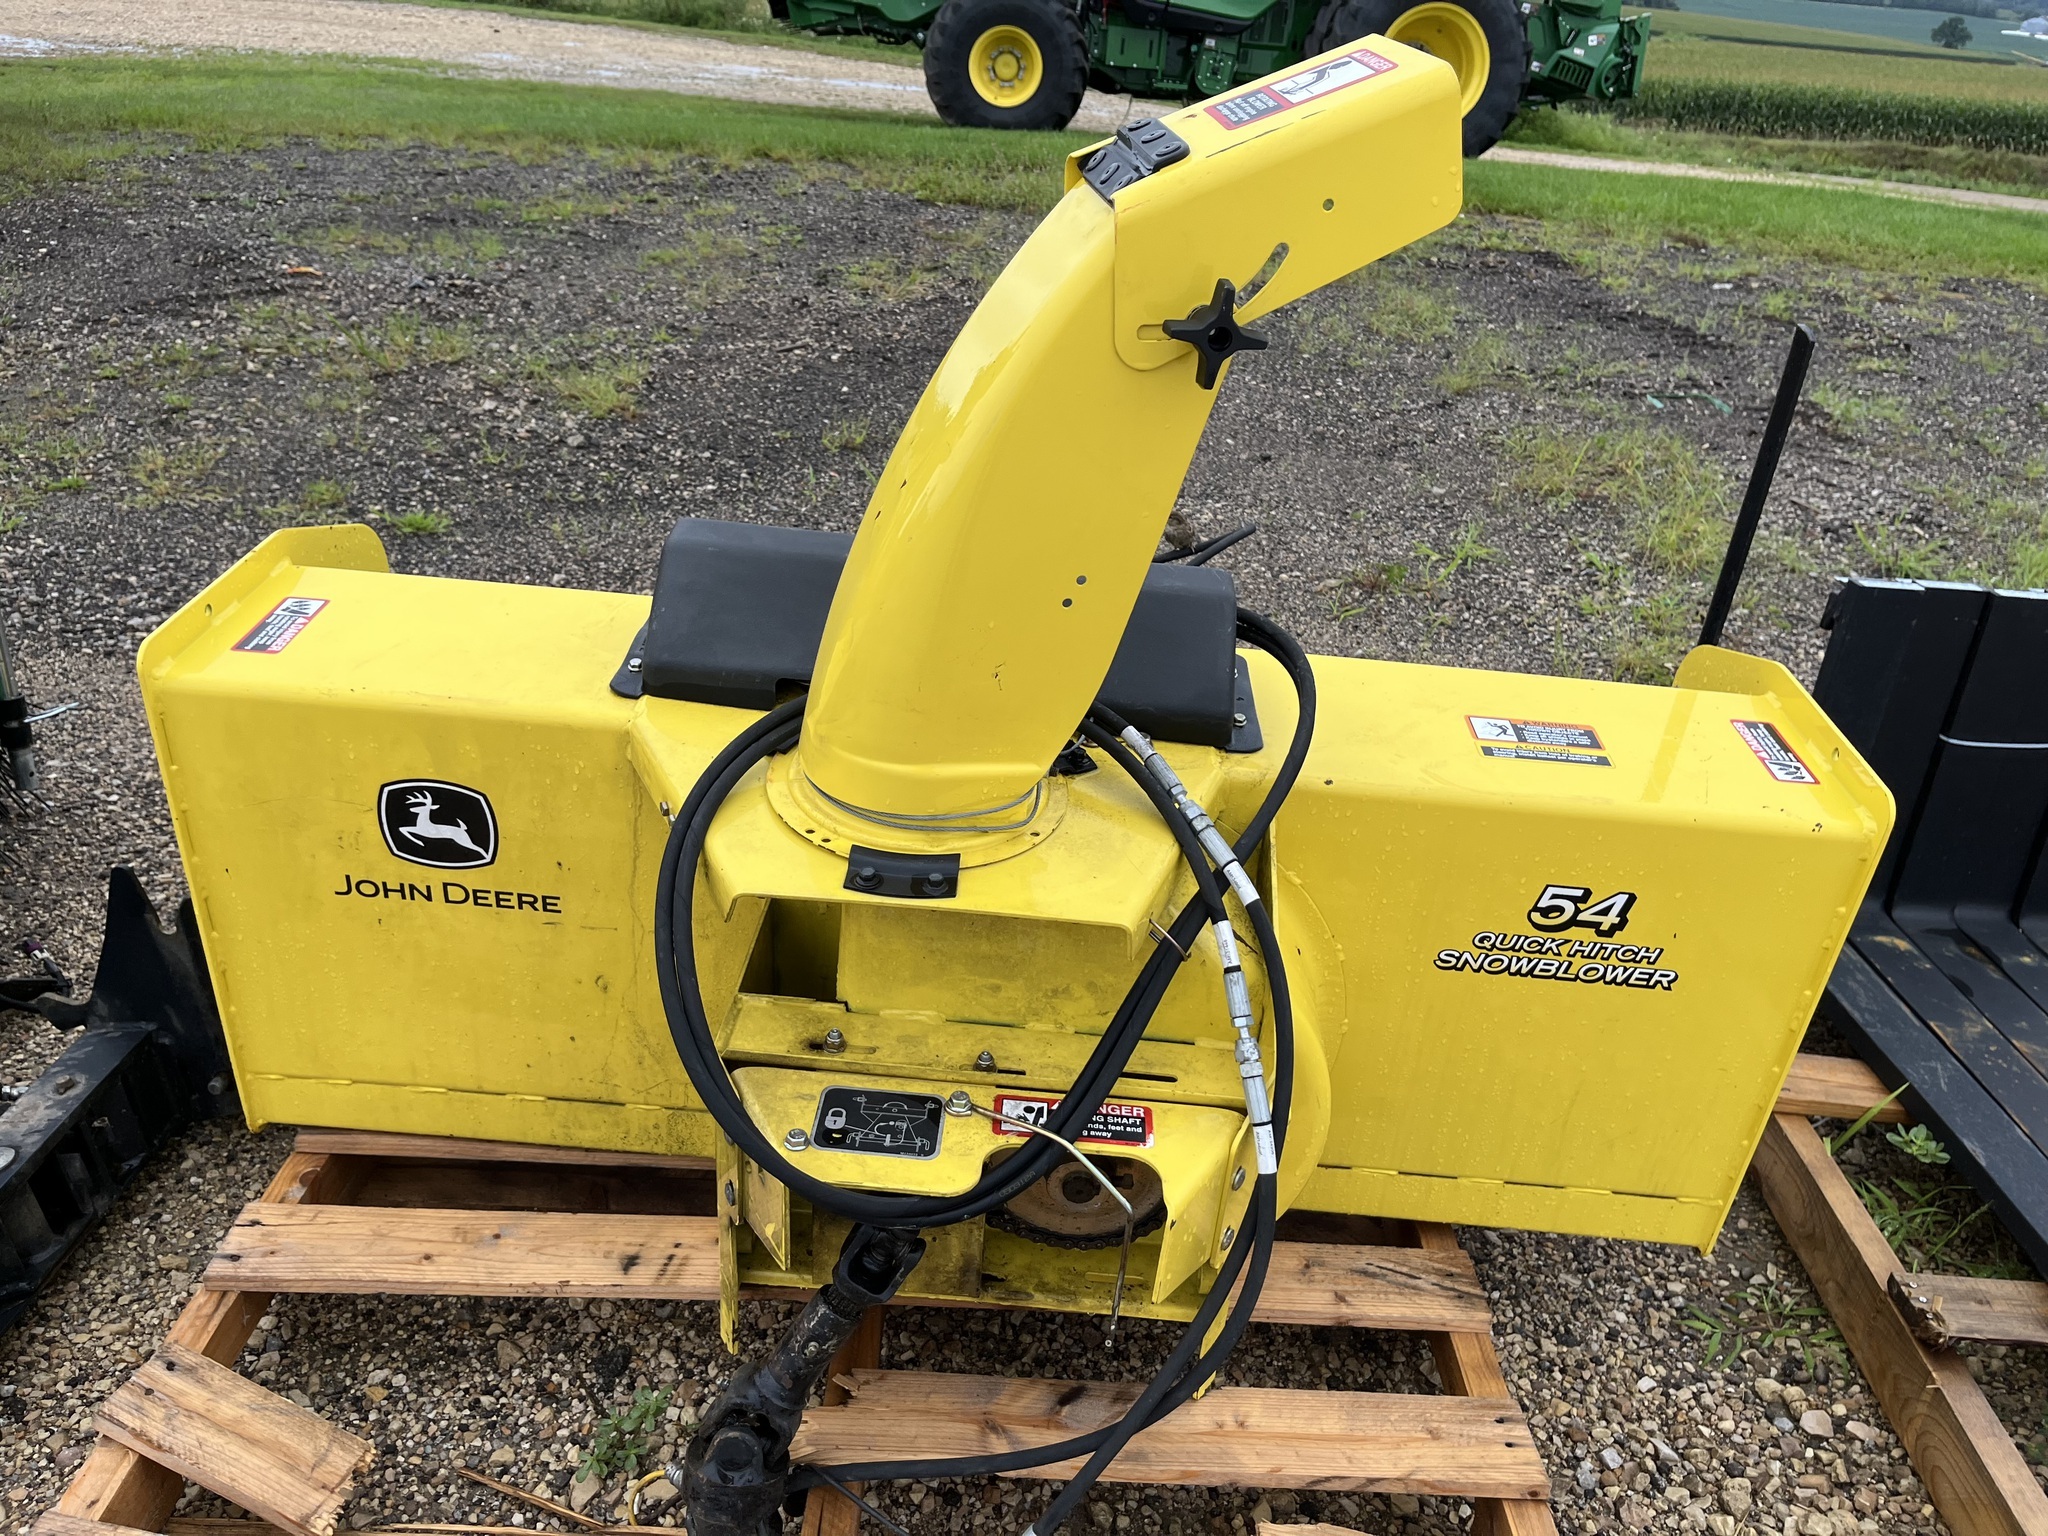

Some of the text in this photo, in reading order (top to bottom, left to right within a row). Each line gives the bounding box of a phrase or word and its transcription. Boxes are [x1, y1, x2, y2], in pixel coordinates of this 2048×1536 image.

[1357, 52, 1394, 71] DANGER
[266, 623, 305, 652] DANGER
[1532, 720, 1580, 729] WARNING
[1733, 721, 1765, 751] DANGER
[1524, 745, 1571, 753] CAUTION
[334, 874, 562, 914] JOHN DEERE
[1527, 884, 1638, 938] 54
[1472, 931, 1664, 965] QUICK HITCH
[1433, 949, 1679, 991] SNOWBLOWER
[1096, 1103, 1145, 1118] NGER
[1087, 1122, 1143, 1133] nds, feet and
[1107, 1115, 1142, 1126] SHAFT
[1090, 1130, 1113, 1138] away
